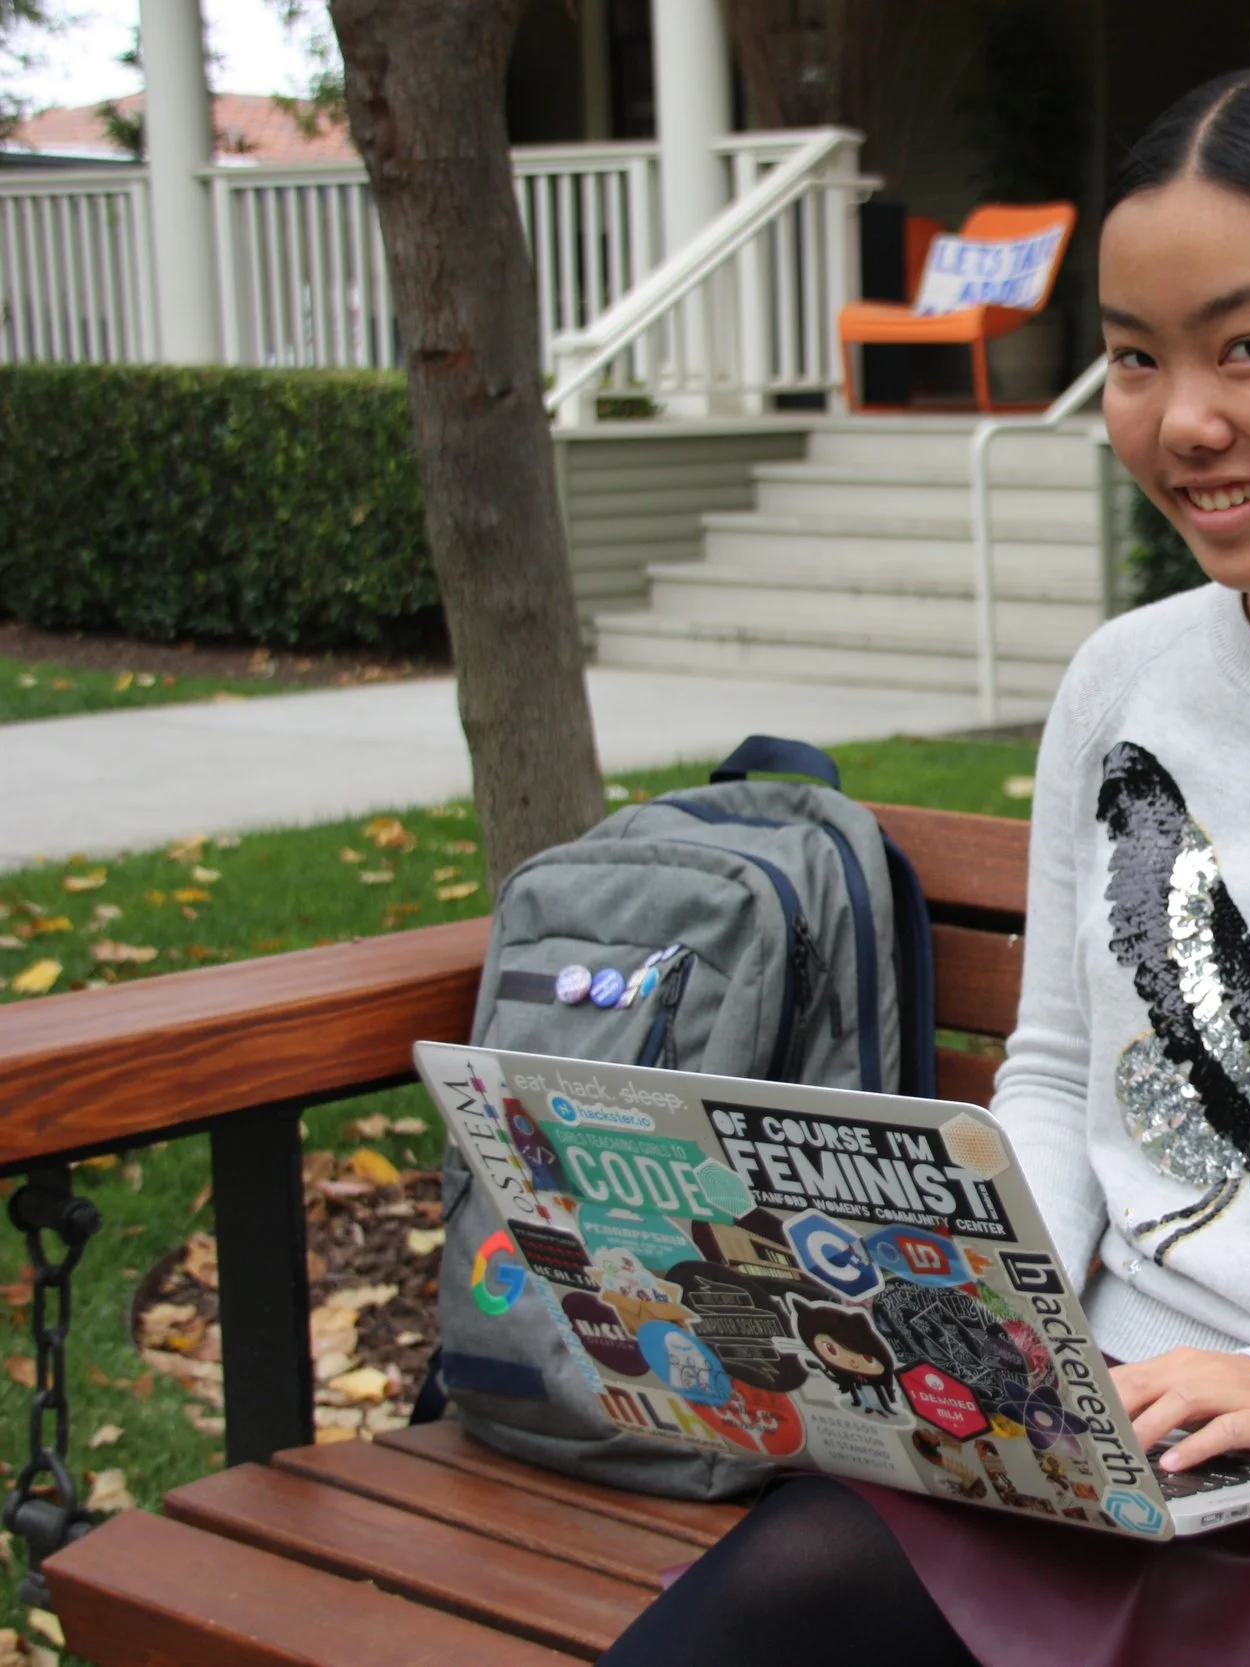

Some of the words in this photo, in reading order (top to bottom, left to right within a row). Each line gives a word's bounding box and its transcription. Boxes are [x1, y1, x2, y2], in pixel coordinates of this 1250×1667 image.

[578, 1104, 651, 1127] hackster.io
[711, 1110, 748, 1138] OF
[762, 1115, 876, 1155] COURSE
[886, 1130, 936, 1162] I'M
[566, 1145, 714, 1216] CODE
[721, 1138, 989, 1220] FEMINIST
[750, 1189, 808, 1210] TANFORD
[813, 1199, 871, 1217] WOMEN'S
[874, 1207, 949, 1227] COMMUNITY
[955, 1217, 1007, 1236] CENTER
[920, 1393, 977, 1412] DEMOED
[936, 1407, 965, 1422] MLH
[811, 1414, 879, 1434] ANDERSON
